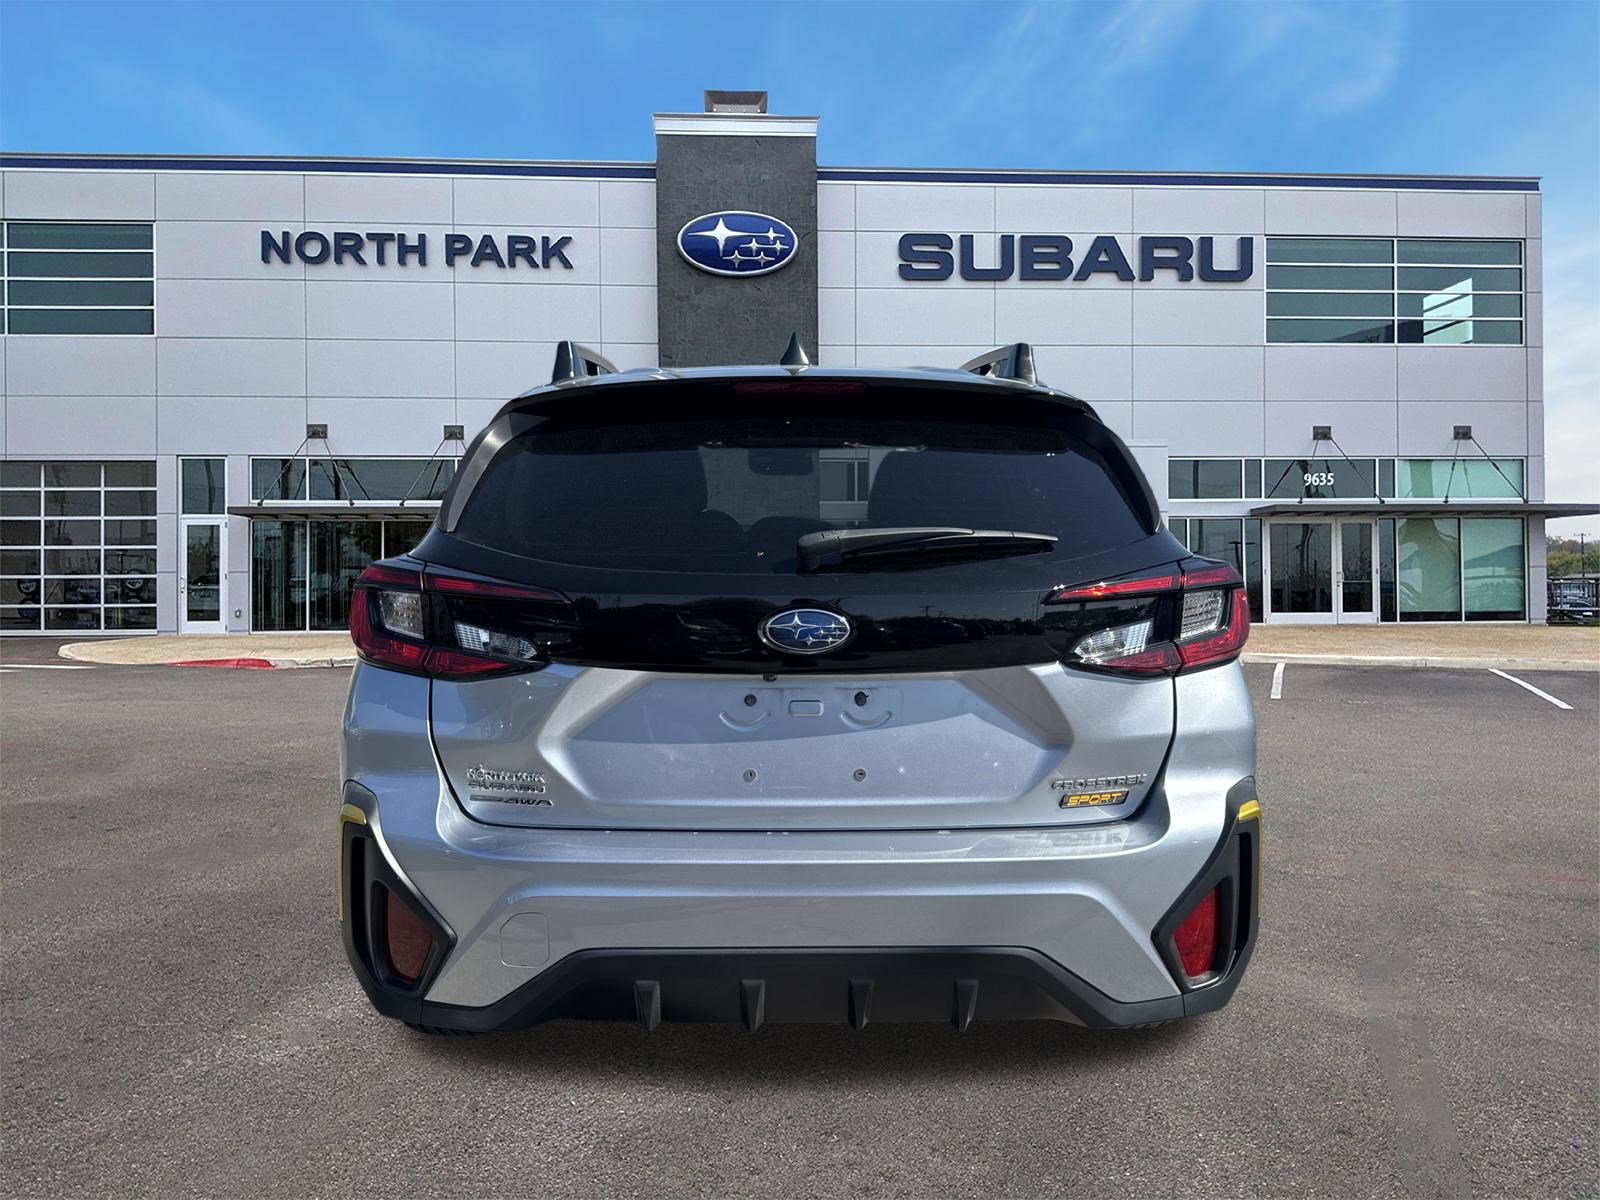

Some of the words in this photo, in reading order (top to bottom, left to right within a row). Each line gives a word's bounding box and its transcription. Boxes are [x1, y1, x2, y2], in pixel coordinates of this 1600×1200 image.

[261, 230, 427, 266] NORTH
[445, 233, 574, 269] PARK
[898, 233, 1254, 283] SUBARU
[1303, 472, 1335, 486] 9635
[467, 780, 546, 794] SUBARU
[1051, 774, 1147, 791] CROSSTREK
[1066, 792, 1122, 806] SPORT
